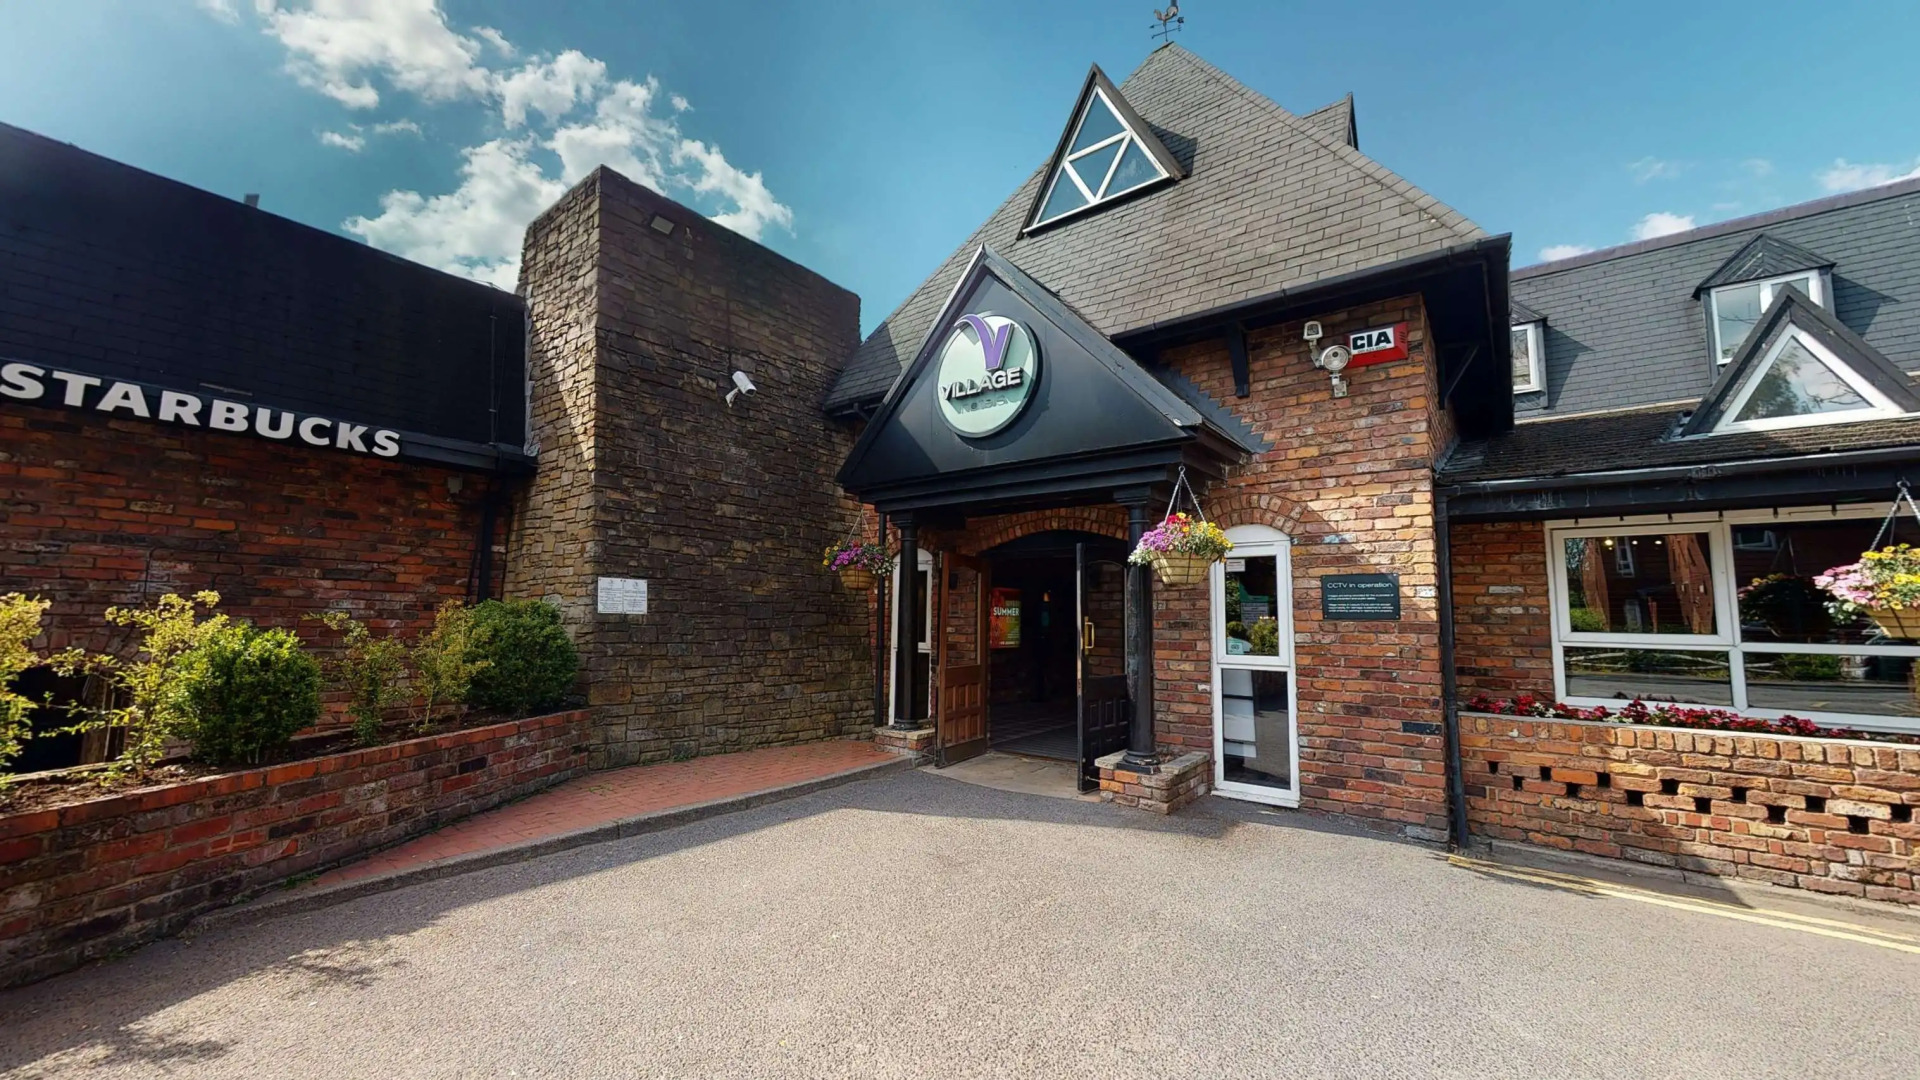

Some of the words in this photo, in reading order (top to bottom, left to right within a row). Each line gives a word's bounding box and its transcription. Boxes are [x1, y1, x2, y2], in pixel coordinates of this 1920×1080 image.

[1352, 331, 1392, 351] CIA
[941, 367, 1022, 400] VILLAGE
[0, 363, 400, 457] STARBUCKS
[993, 607, 1020, 616] SUMMER
